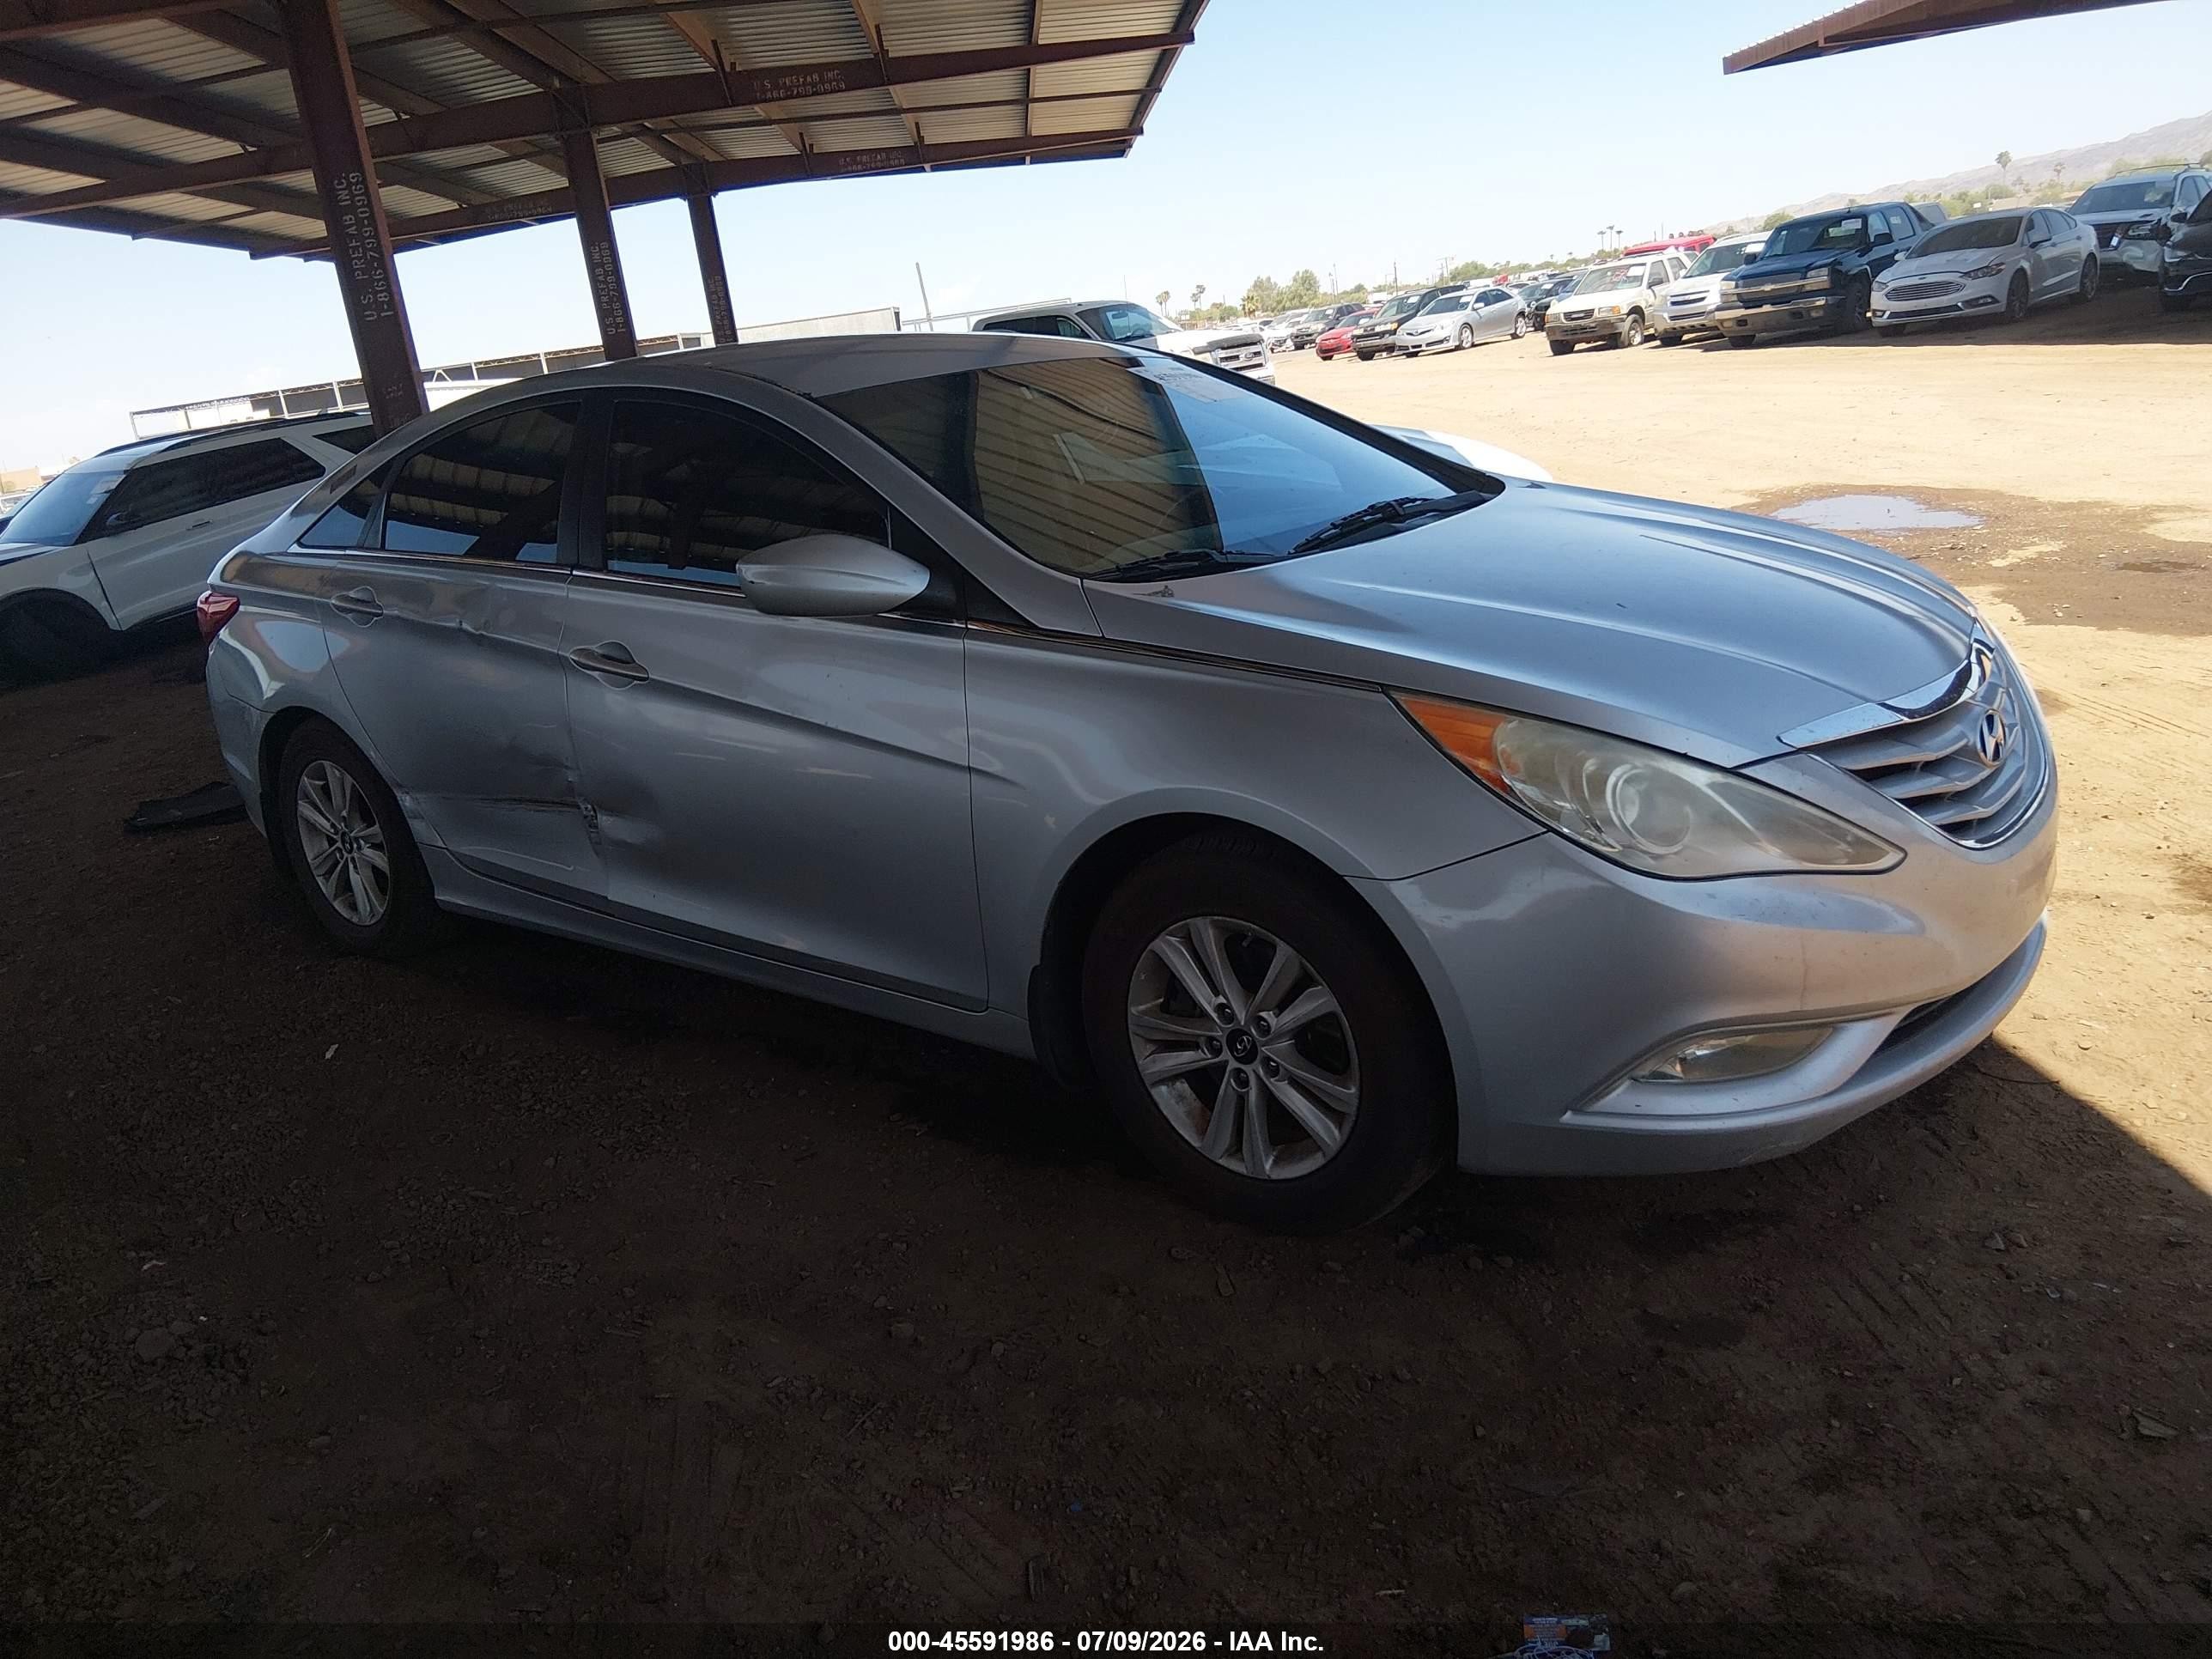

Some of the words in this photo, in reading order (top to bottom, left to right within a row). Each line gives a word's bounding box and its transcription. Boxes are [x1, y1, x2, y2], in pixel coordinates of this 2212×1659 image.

[779, 72, 819, 88] PREFAB
[824, 70, 844, 82] INC.
[333, 172, 351, 205] INC.
[343, 215, 370, 280] PREFAB
[349, 171, 394, 317] 1-866-799-0969
[590, 241, 602, 263] INC.
[361, 288, 377, 321] U.S.
[594, 268, 611, 309] PREFAB
